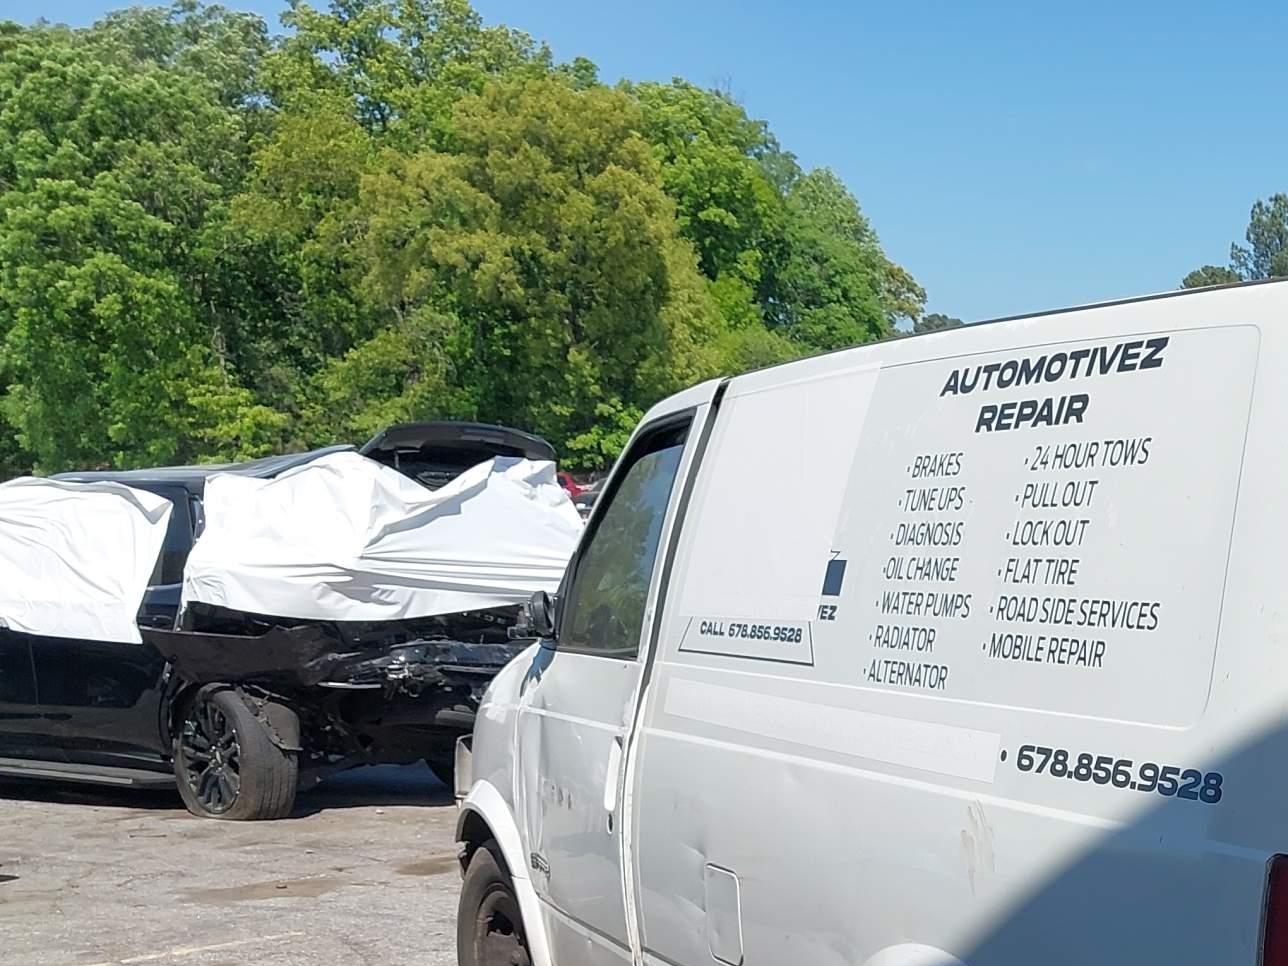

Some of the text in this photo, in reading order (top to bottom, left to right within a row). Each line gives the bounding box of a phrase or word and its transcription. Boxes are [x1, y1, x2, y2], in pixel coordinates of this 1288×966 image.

[940, 337, 1170, 397] AUTOMOTIVEZ
[975, 394, 1089, 433] REPAIR
[912, 453, 963, 478] BRAKES
[1030, 437, 1152, 470] 24 HOUR TOWS
[904, 487, 965, 512] TUNE UPS
[1021, 480, 1098, 508] PULL OUT
[896, 522, 963, 546] DIAGNOSIS
[1012, 520, 1090, 545] LOCK OUT
[886, 557, 959, 582] OIL CHANGE
[1004, 558, 1080, 585] FLAT TIRE
[881, 591, 972, 619] WATER PUMPS
[996, 596, 1160, 631] ROAD SIDE SERVICES
[700, 621, 802, 643] CALL 678.856.9528
[874, 625, 936, 652] RADIATOR
[988, 633, 1106, 668] MOBILE REPAIR
[867, 659, 949, 690] ALTERNATOR
[1016, 745, 1224, 804] 678.856.9528
